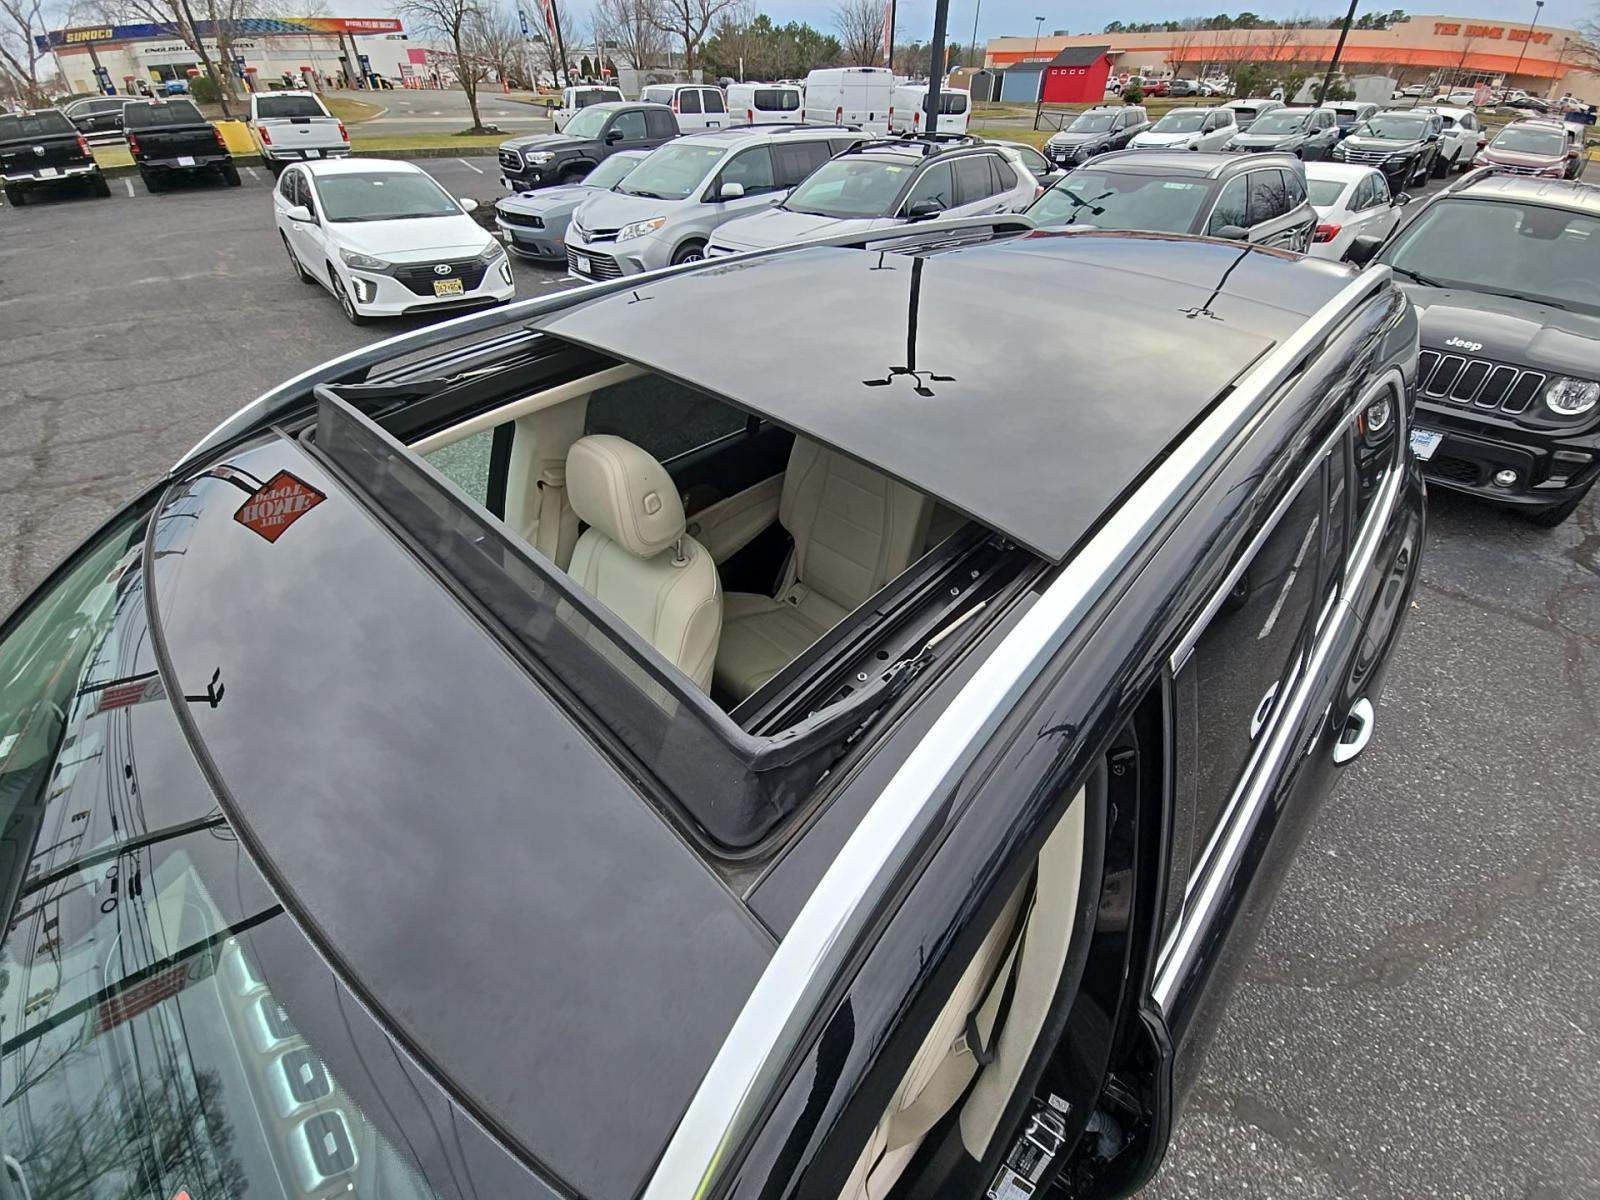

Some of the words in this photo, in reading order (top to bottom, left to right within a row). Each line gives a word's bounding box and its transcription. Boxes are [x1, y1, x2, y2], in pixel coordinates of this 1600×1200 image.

[66, 29, 113, 42] SUNOCO
[1434, 23, 1461, 35] THE
[1463, 25, 1504, 39] HOME
[1507, 29, 1552, 44] DEPOT
[1445, 337, 1483, 352] Jeep
